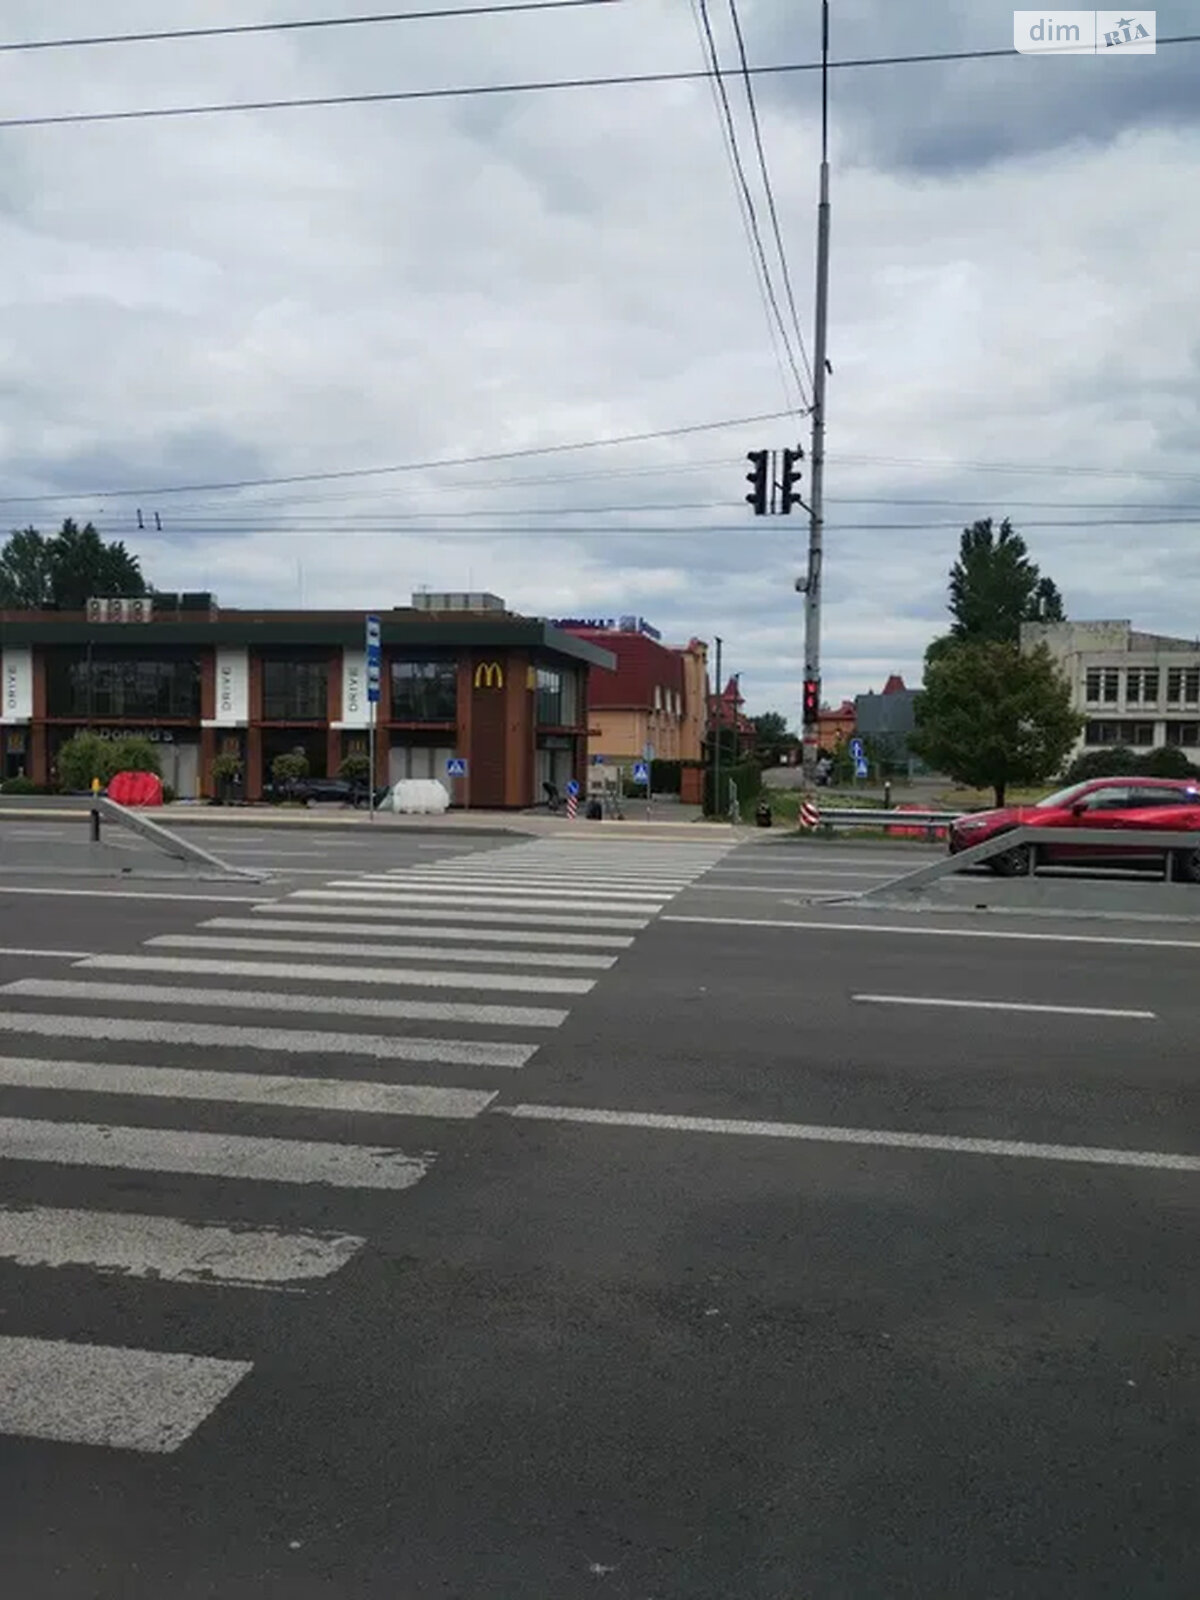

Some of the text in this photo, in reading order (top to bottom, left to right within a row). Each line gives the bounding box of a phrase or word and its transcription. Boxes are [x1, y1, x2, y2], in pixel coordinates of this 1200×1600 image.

[8, 665, 17, 709] DRIVE
[221, 666, 232, 711] DRIVE
[348, 667, 358, 712] DRIVE
